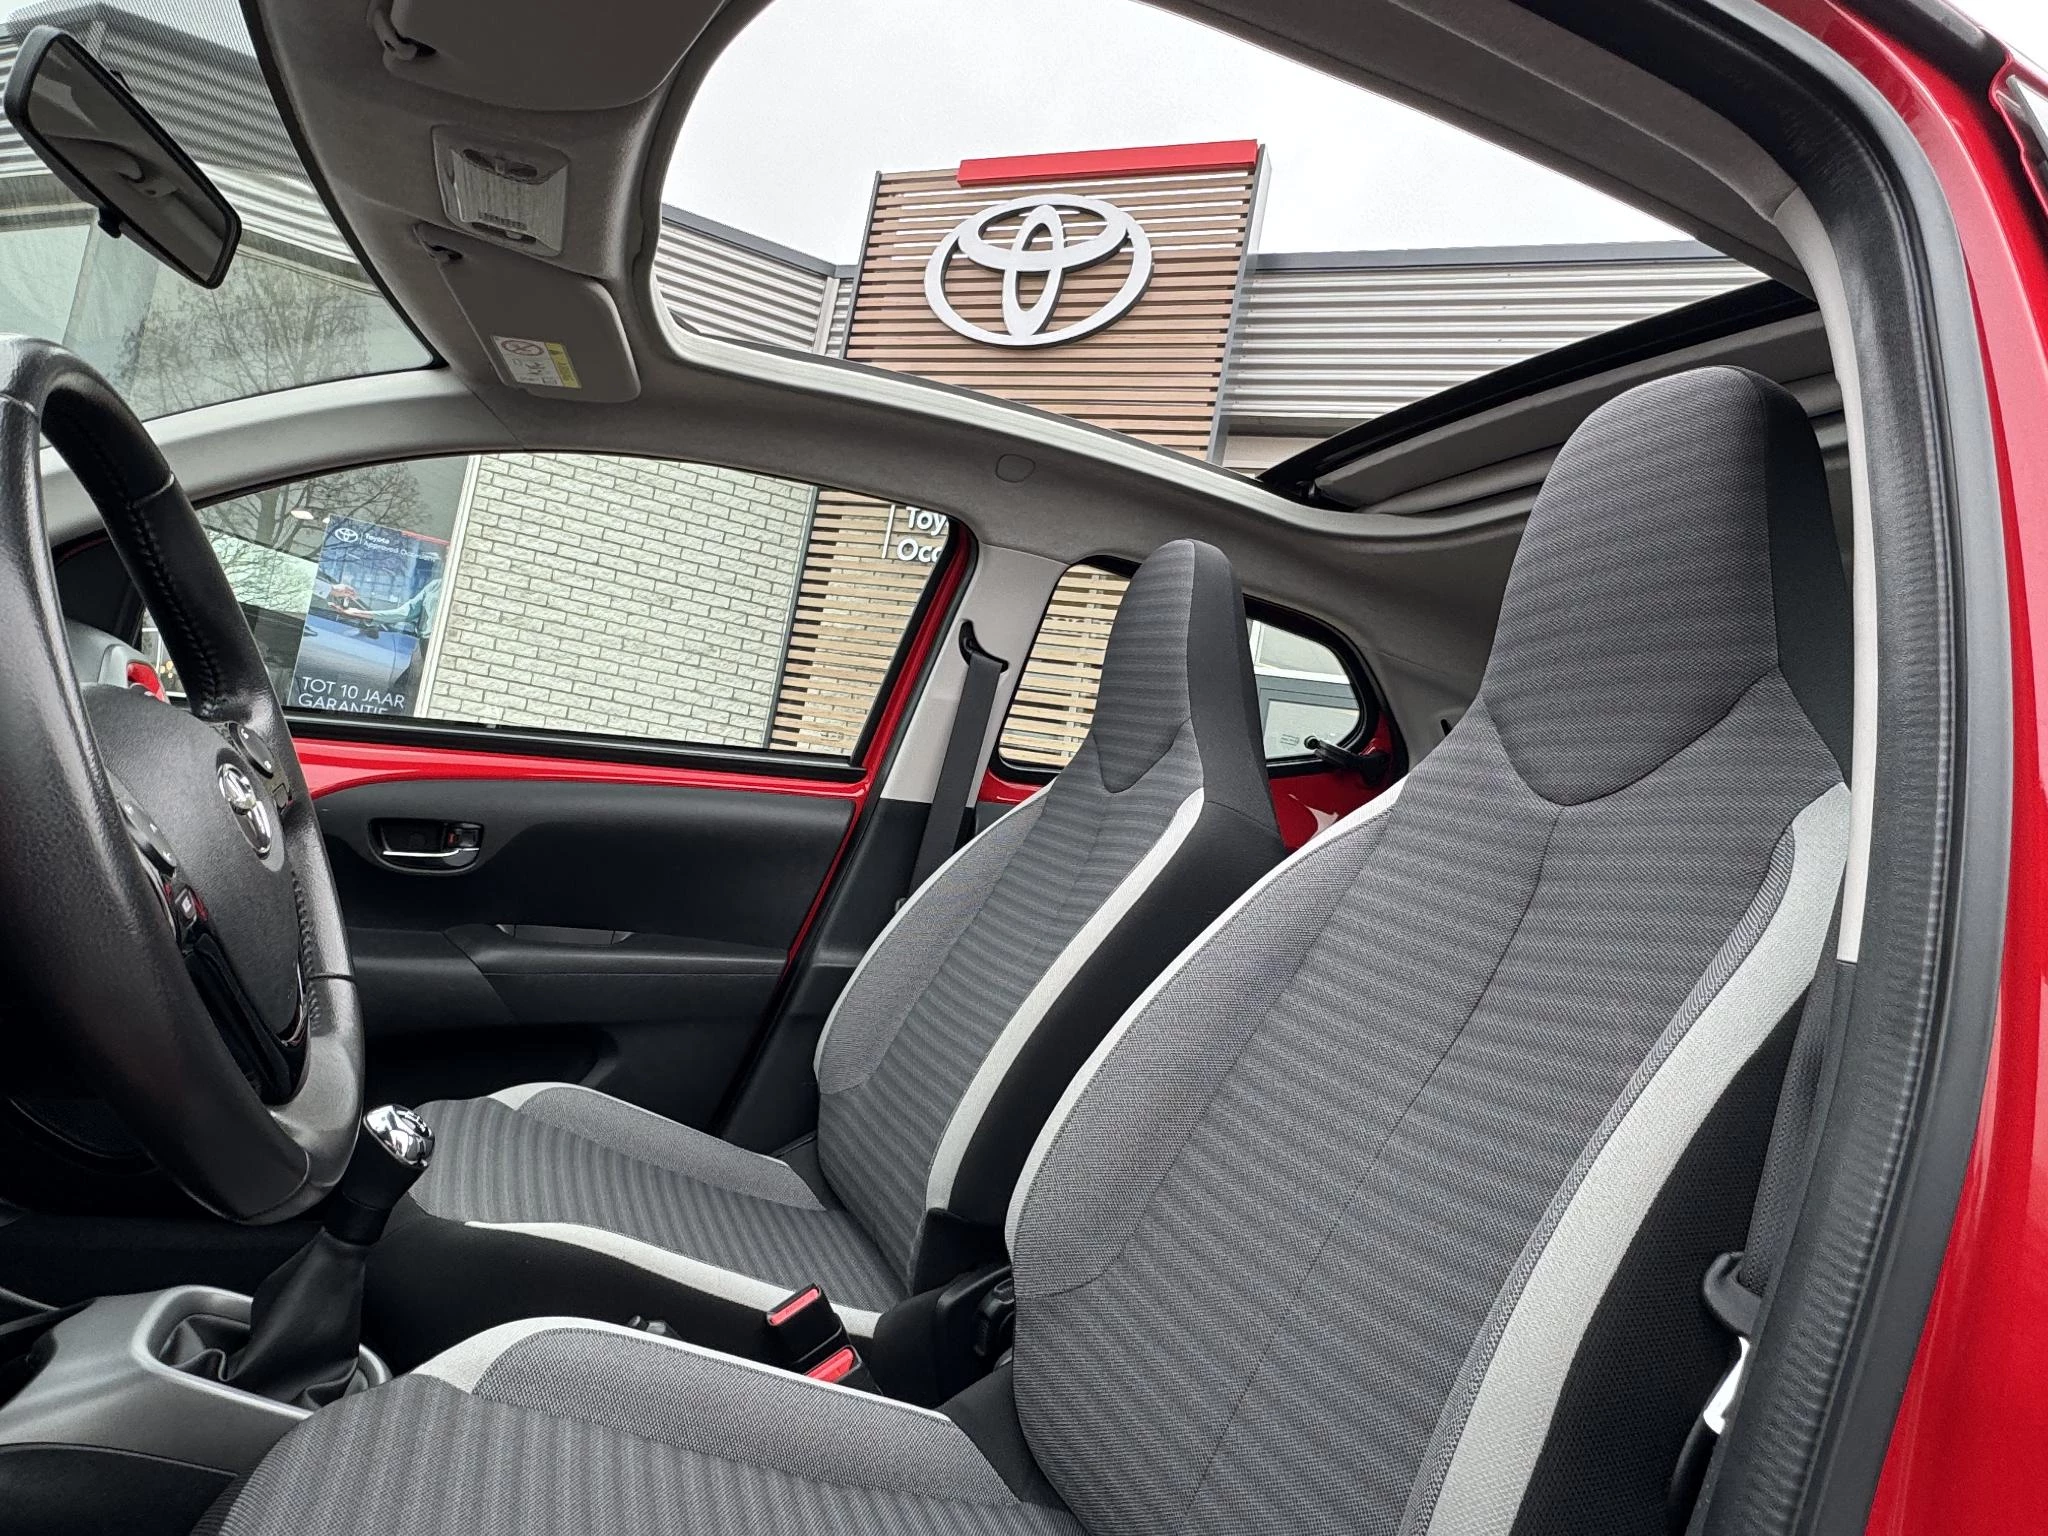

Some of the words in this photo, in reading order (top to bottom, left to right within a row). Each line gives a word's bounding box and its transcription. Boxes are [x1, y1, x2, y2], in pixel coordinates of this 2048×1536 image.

[906, 506, 949, 536] Toy
[364, 541, 399, 554] Approved
[365, 533, 390, 545] Toyota
[302, 676, 336, 695] TOT
[341, 684, 358, 699] 10
[362, 689, 405, 709] JAAR
